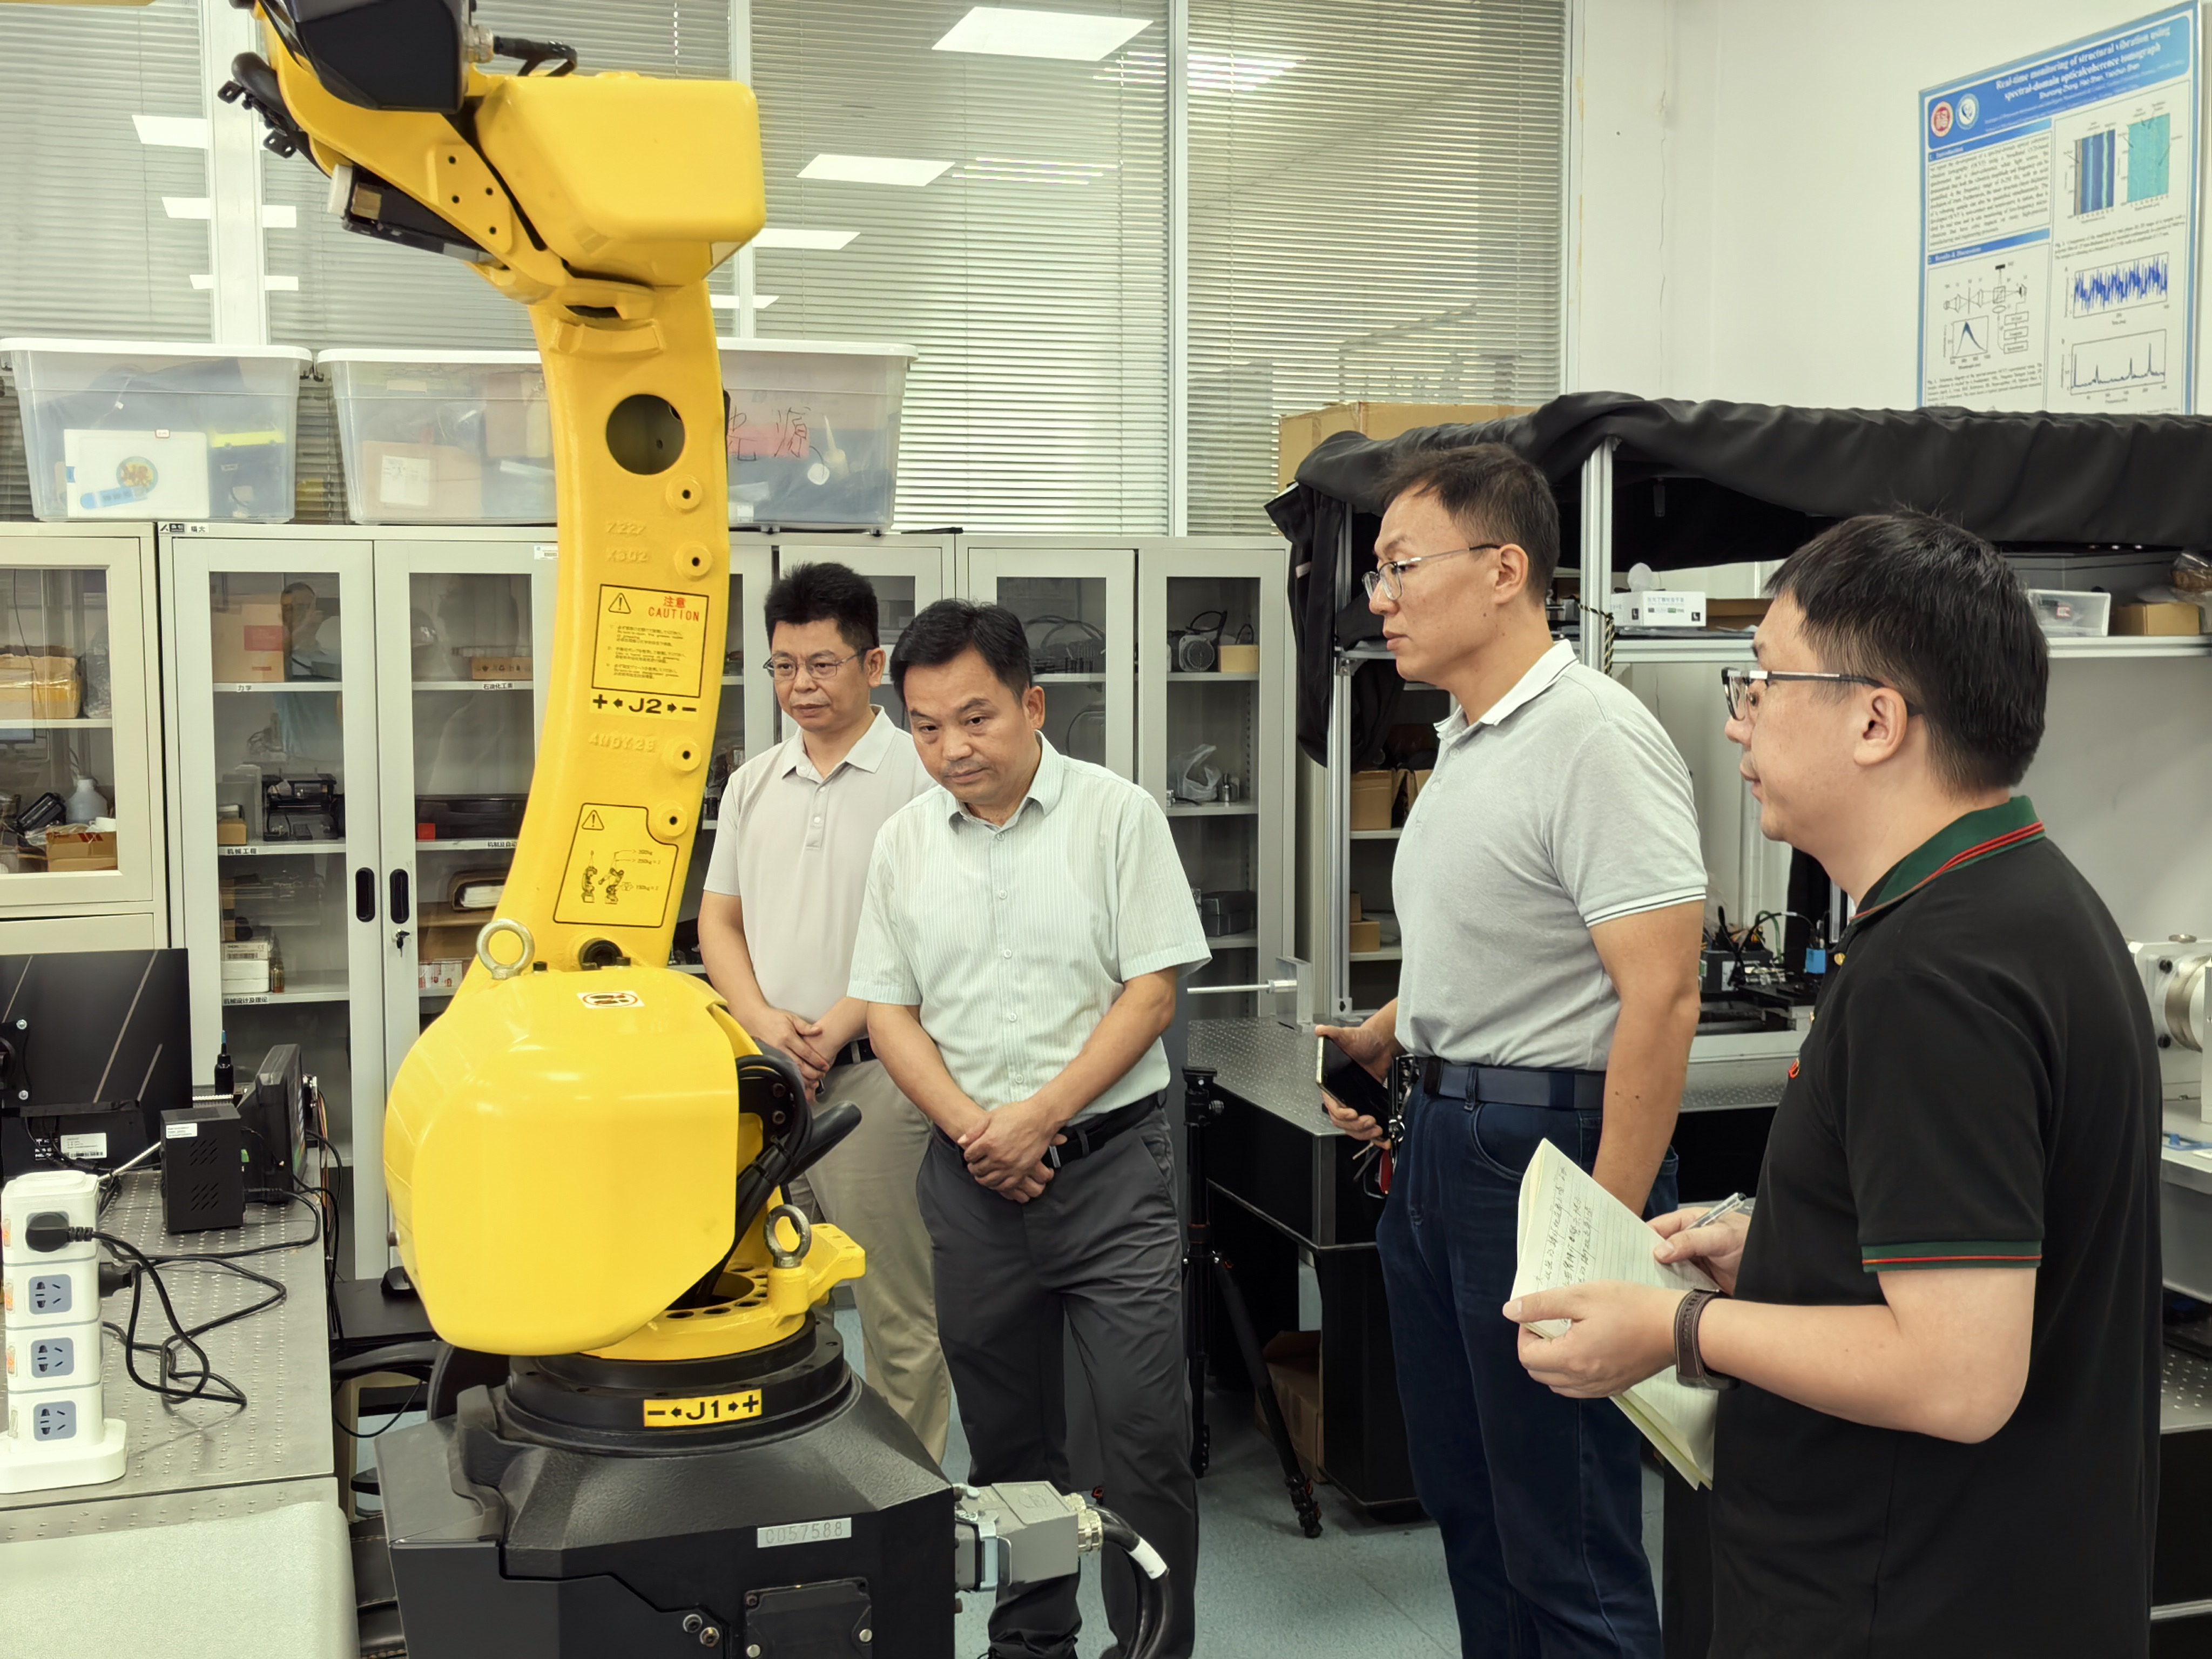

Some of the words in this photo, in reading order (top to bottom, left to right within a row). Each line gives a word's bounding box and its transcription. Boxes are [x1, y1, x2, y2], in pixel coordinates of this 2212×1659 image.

[663, 596, 686, 609] 注意
[649, 606, 699, 622] CAUTION
[629, 698, 662, 714] J2
[686, 1400, 719, 1420] J1
